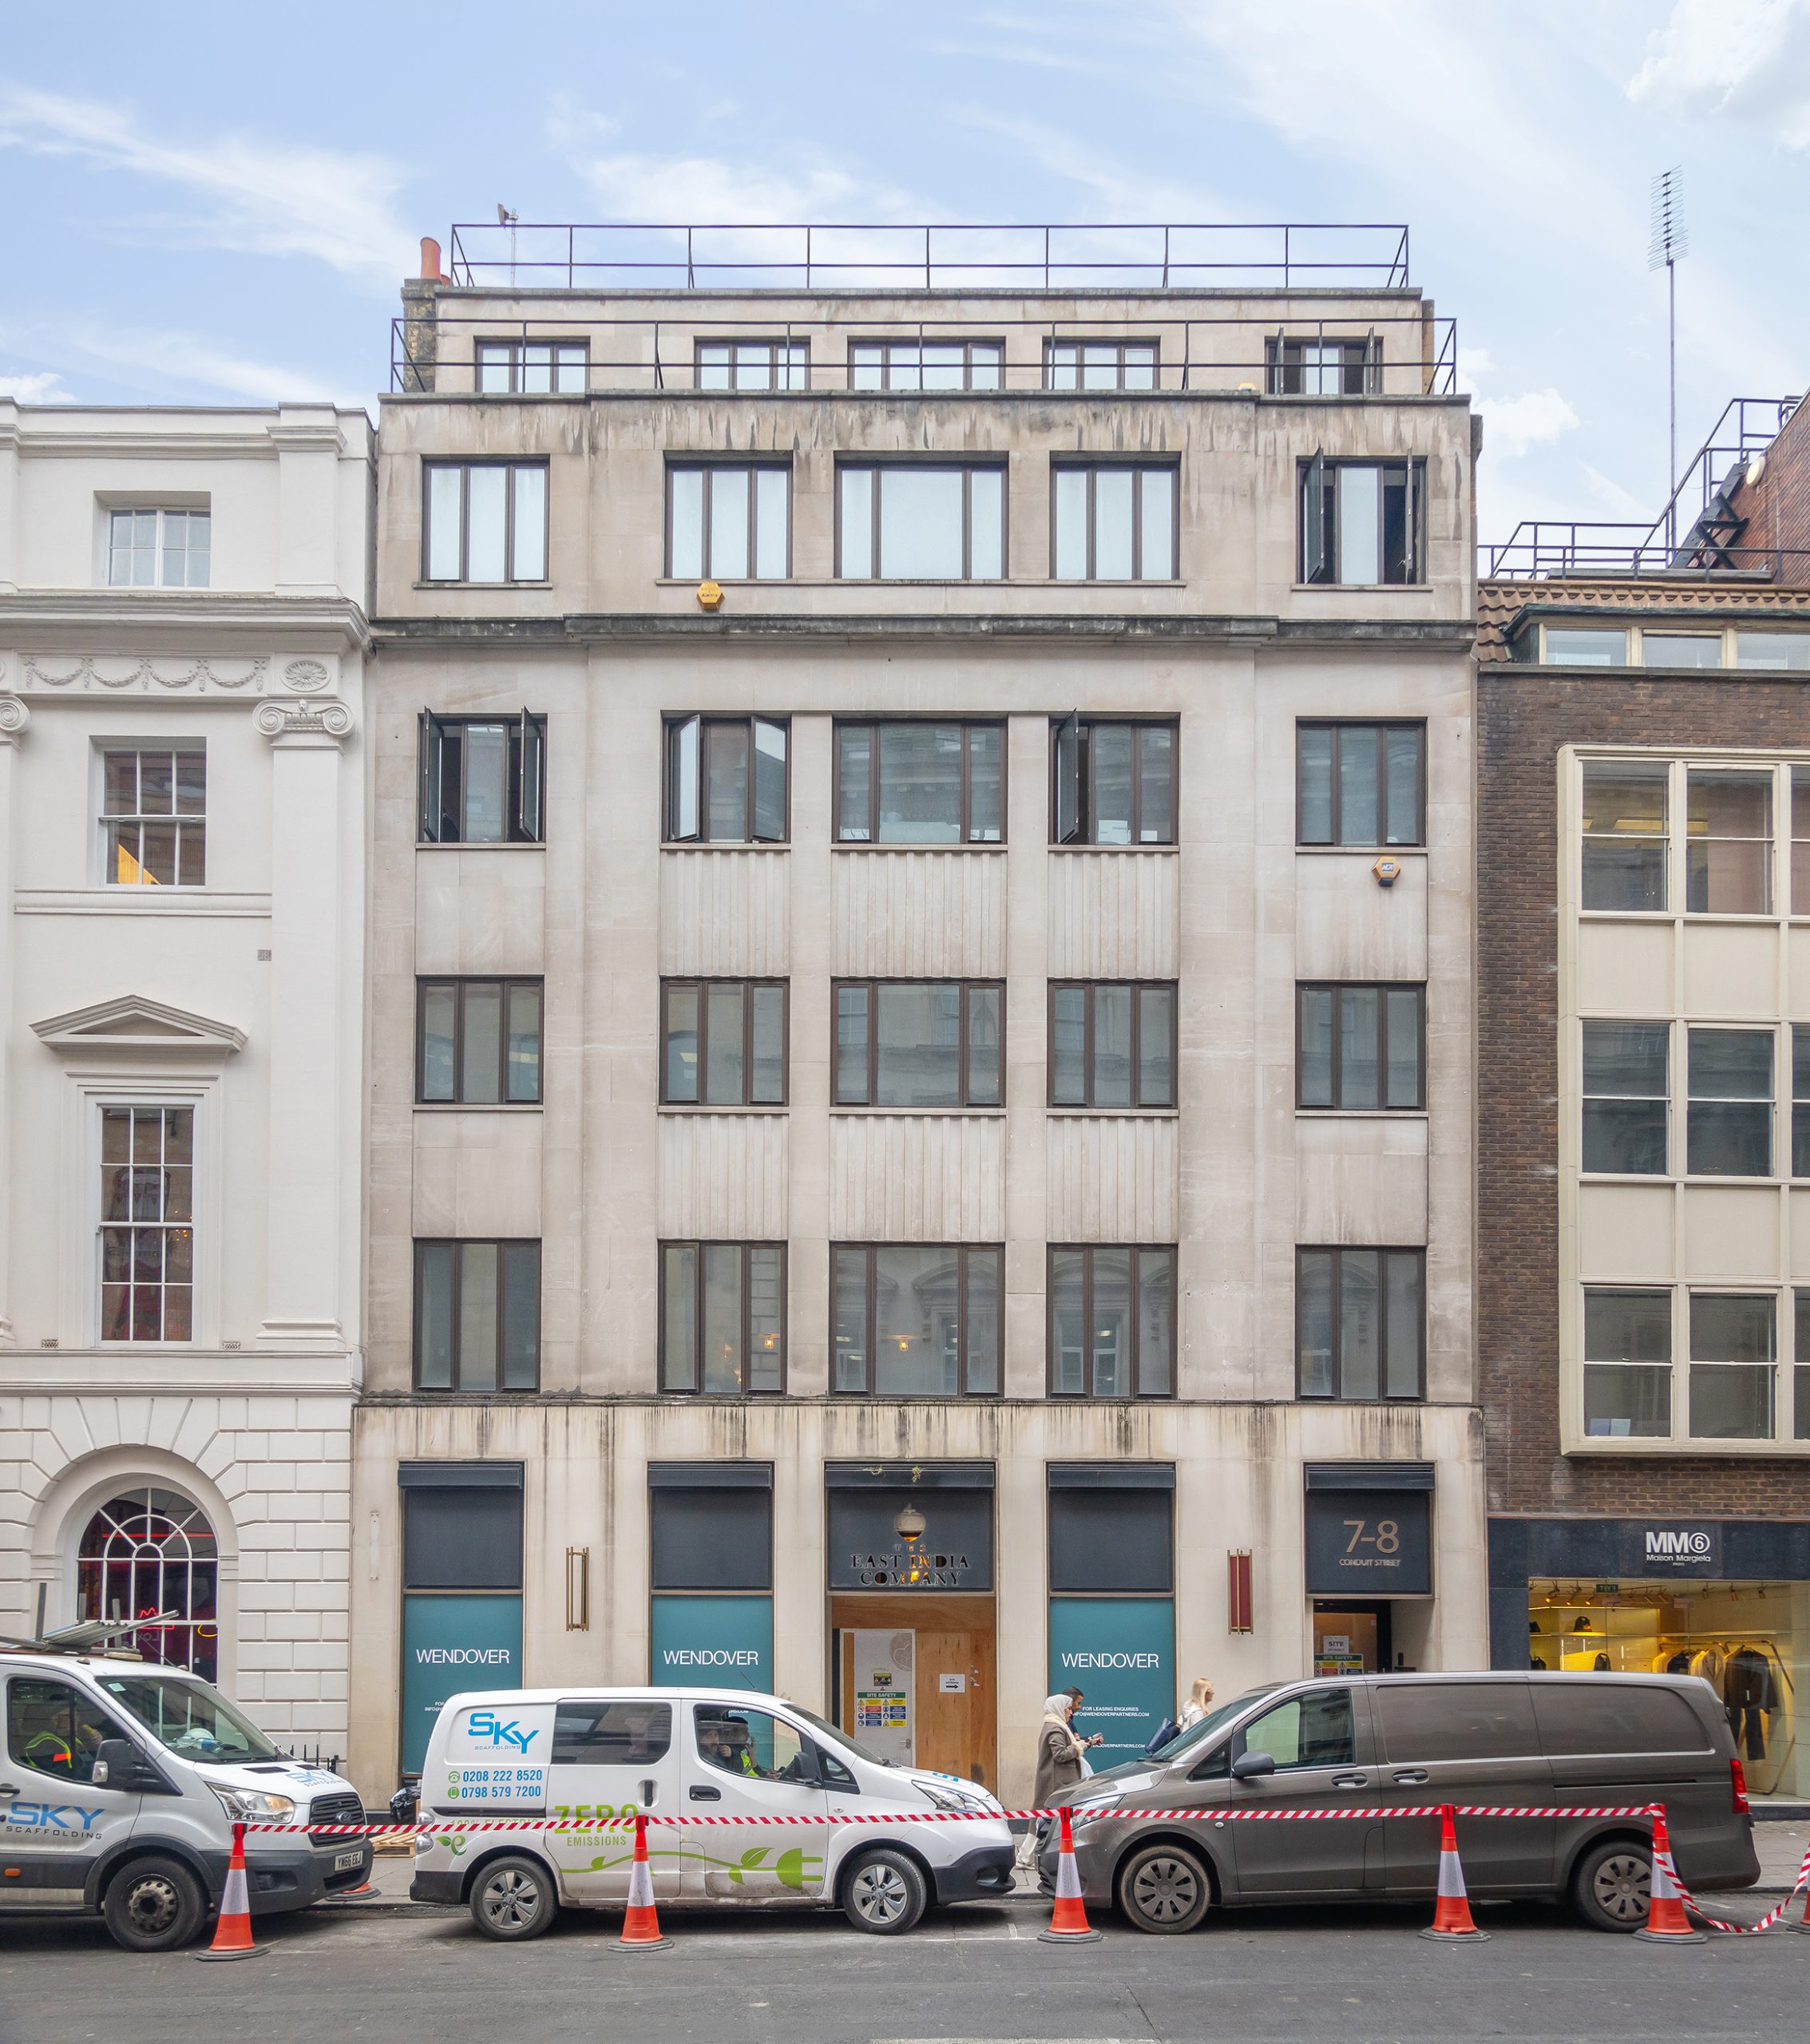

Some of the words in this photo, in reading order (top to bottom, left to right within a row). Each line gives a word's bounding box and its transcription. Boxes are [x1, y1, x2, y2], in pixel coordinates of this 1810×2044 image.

[1344, 1520, 1400, 1554] 7-8
[850, 1554, 902, 1569] EAST
[909, 1554, 969, 1569] INDIA
[1676, 1555, 1711, 1563] Margiela
[860, 1571, 962, 1586] COMPANY
[416, 1649, 510, 1664] WENDOVER
[663, 1650, 758, 1666] WENDOVER
[1062, 1653, 1159, 1668] WENDOVER
[468, 1713, 540, 1754] SKY
[463, 1771, 489, 1782] 0208
[493, 1770, 512, 1781] 222
[517, 1769, 542, 1781] 8520
[461, 1787, 487, 1798] 0798
[492, 1786, 511, 1797] 579
[516, 1785, 541, 1796] 7200
[8, 1802, 105, 1830] SKY
[554, 1804, 639, 1833] ZERO
[6, 1826, 102, 1840] SCAFFOLDING
[567, 1836, 626, 1846] EMISSIONS
